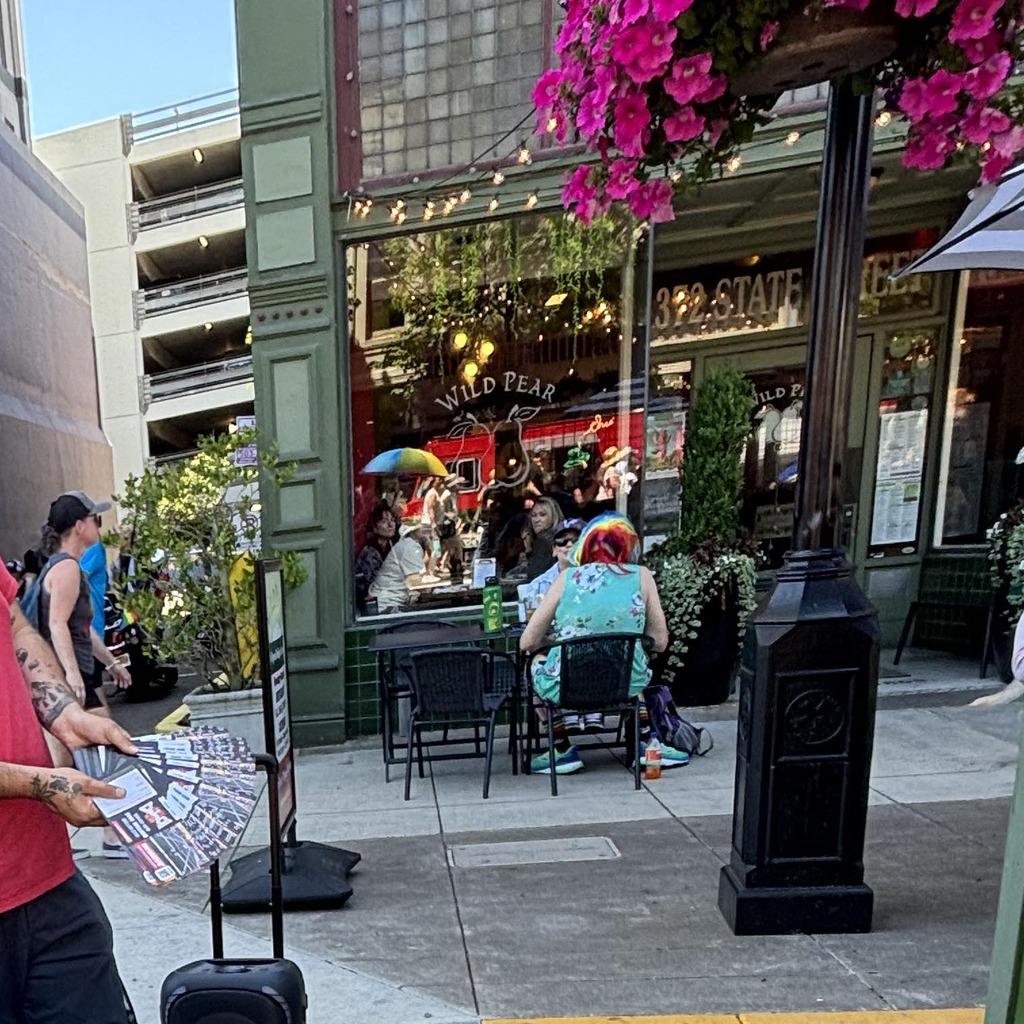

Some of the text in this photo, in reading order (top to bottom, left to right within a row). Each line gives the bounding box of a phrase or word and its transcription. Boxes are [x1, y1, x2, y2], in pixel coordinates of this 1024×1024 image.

[655, 283, 707, 330] 372
[714, 267, 804, 320] STATE
[434, 370, 556, 411] WILD PEAR
